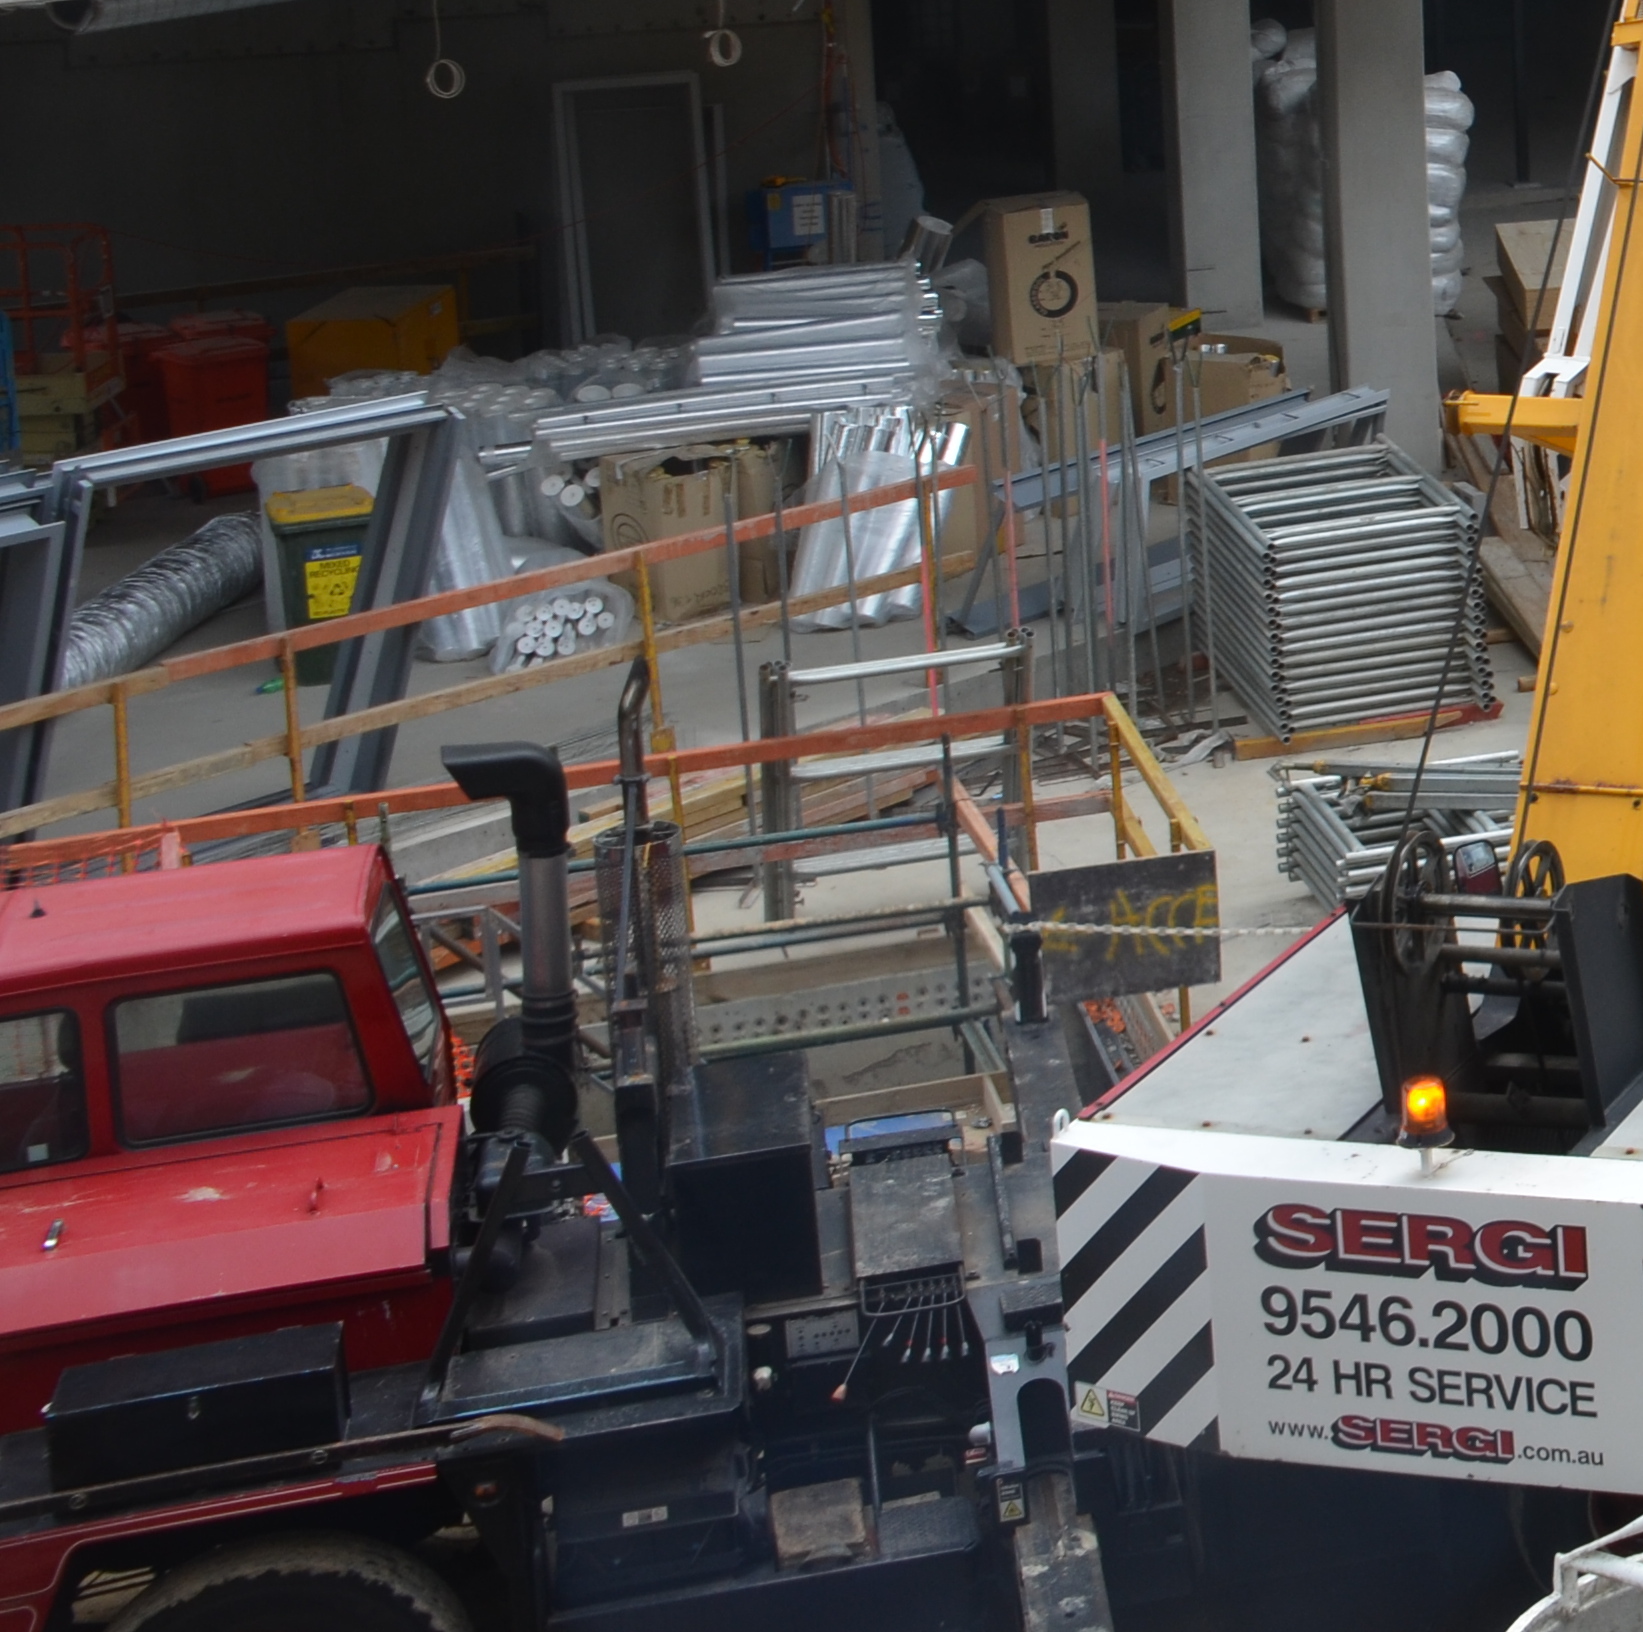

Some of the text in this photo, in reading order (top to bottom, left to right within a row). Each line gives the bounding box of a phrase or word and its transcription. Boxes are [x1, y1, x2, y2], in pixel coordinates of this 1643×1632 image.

[1254, 1202, 1589, 1292] SERGI
[1260, 1285, 1593, 1362] 9546.2000
[1267, 1354, 1598, 1418] 24 HR SERVICE
